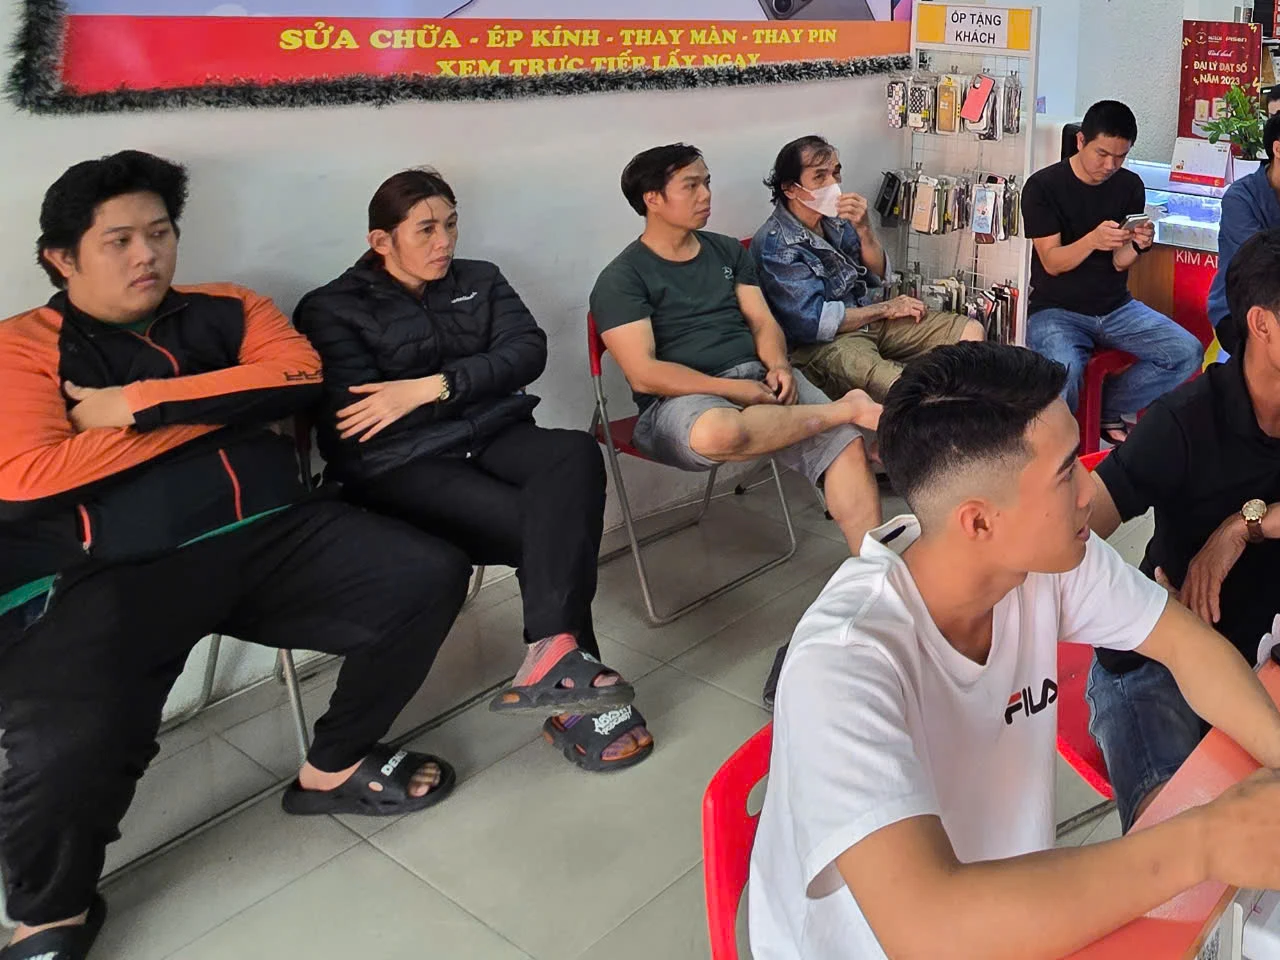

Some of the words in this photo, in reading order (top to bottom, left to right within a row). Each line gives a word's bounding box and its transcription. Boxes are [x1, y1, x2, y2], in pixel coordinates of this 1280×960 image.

[970, 11, 1002, 29] TẶNG
[279, 21, 360, 50] SỬA
[369, 24, 462, 49] CHỮA
[486, 24, 523, 48] ÉP
[531, 24, 600, 48] KÍNH
[619, 29, 685, 46] THAY
[689, 25, 737, 46] MÀN
[752, 29, 804, 44] THAY
[808, 29, 837, 43] PIN
[955, 28, 996, 45] KHÁCH
[436, 59, 502, 77] XEM
[591, 50, 646, 72] TIẾP
[652, 49, 697, 69] LẤY
[703, 53, 761, 70] NGAY
[1193, 61, 1207, 71] ĐẠI
[1209, 60, 1218, 71] LÝ
[1219, 62, 1235, 73] ĐẠT
[1236, 61, 1248, 73] SỐ
[1200, 73, 1219, 84] NĂM
[1220, 76, 1240, 85] 2023
[1176, 250, 1200, 265] KIM
[1004, 678, 1058, 725] FILA
